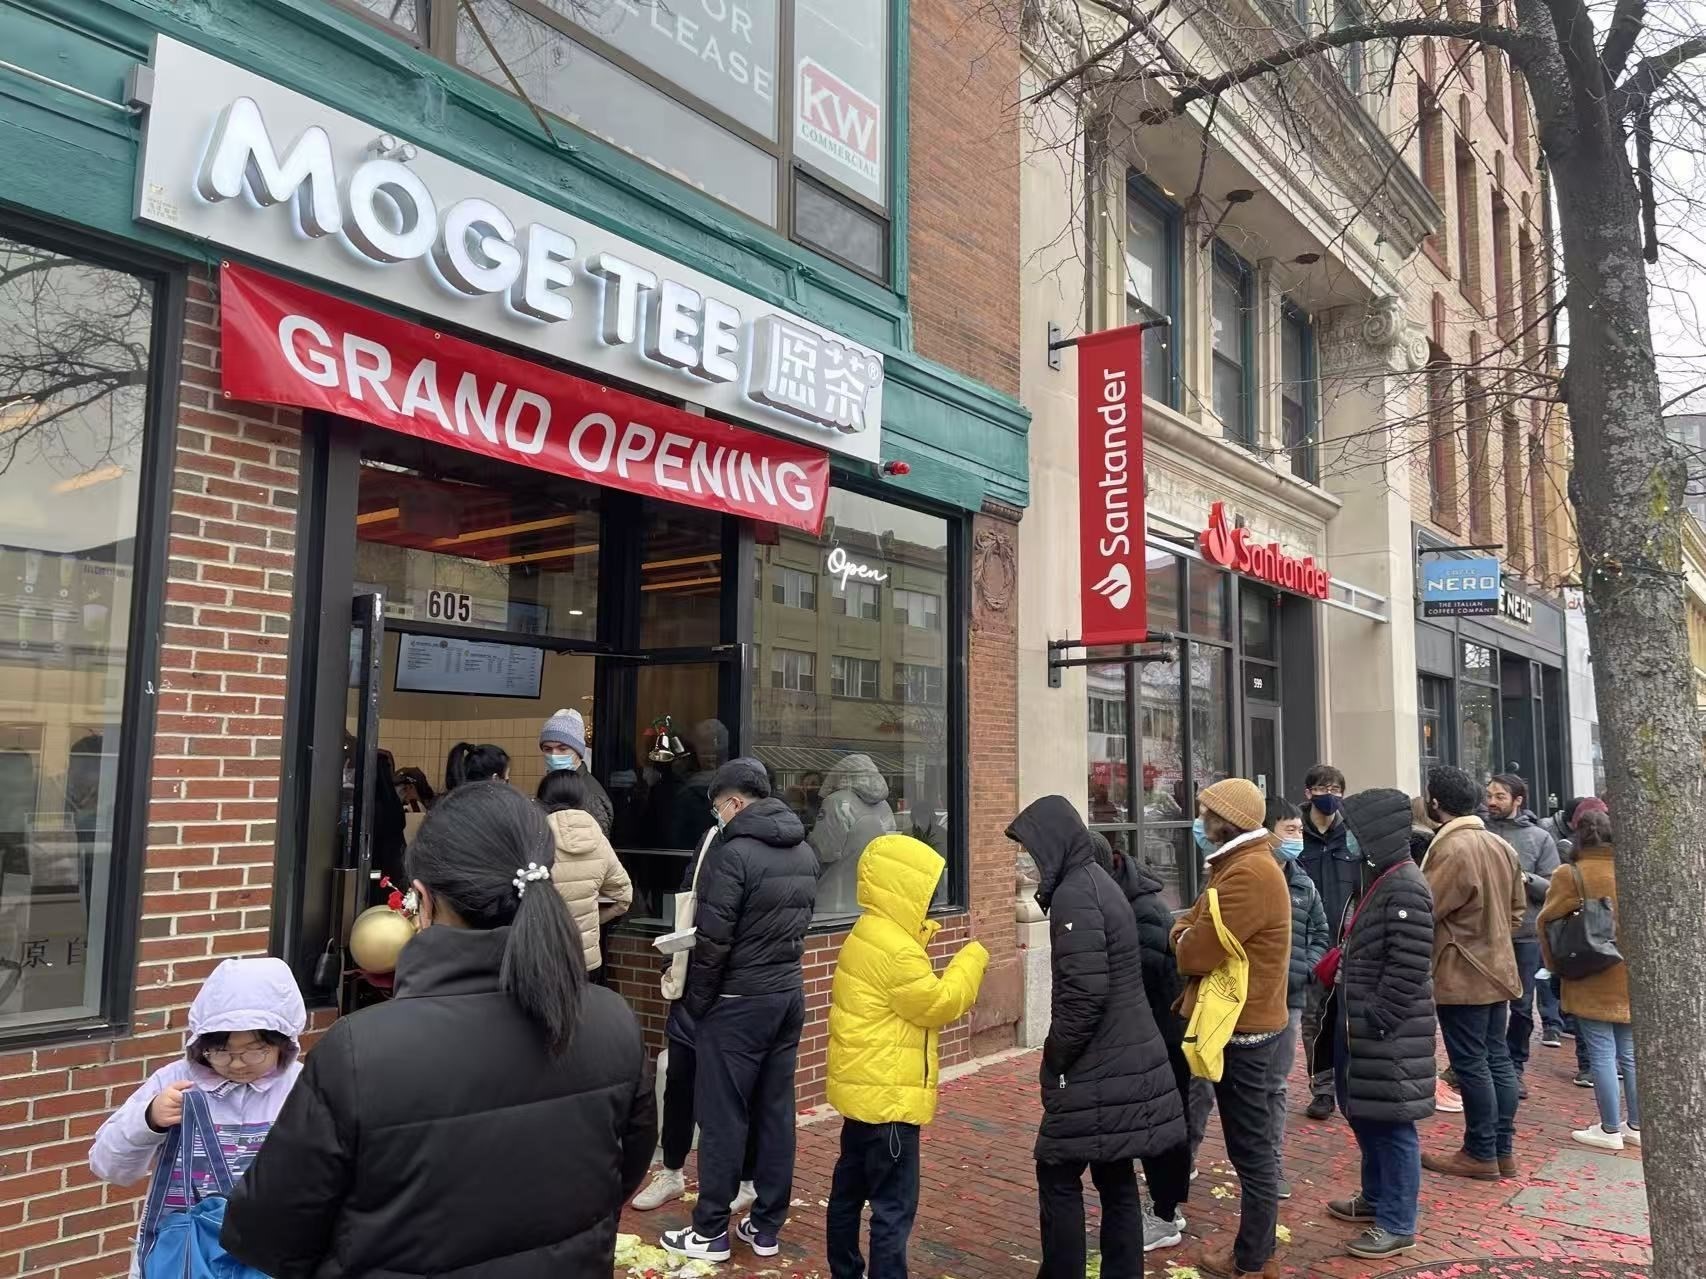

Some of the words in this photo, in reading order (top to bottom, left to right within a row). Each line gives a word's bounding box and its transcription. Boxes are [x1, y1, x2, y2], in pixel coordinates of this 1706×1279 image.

[650, 0, 770, 99] LEASE
[802, 74, 874, 153] KW
[801, 124, 877, 177] COMMERCIAL
[590, 251, 743, 383] TEE
[278, 314, 552, 455] GRAND
[568, 411, 815, 511] OPENING
[1097, 368, 1130, 557] Santander
[828, 547, 888, 591] Open
[1232, 528, 1331, 599] Santander
[1428, 576, 1495, 592] NERO
[429, 590, 470, 622] 605
[1506, 592, 1532, 624] NERO
[1253, 677, 1263, 689] 599
